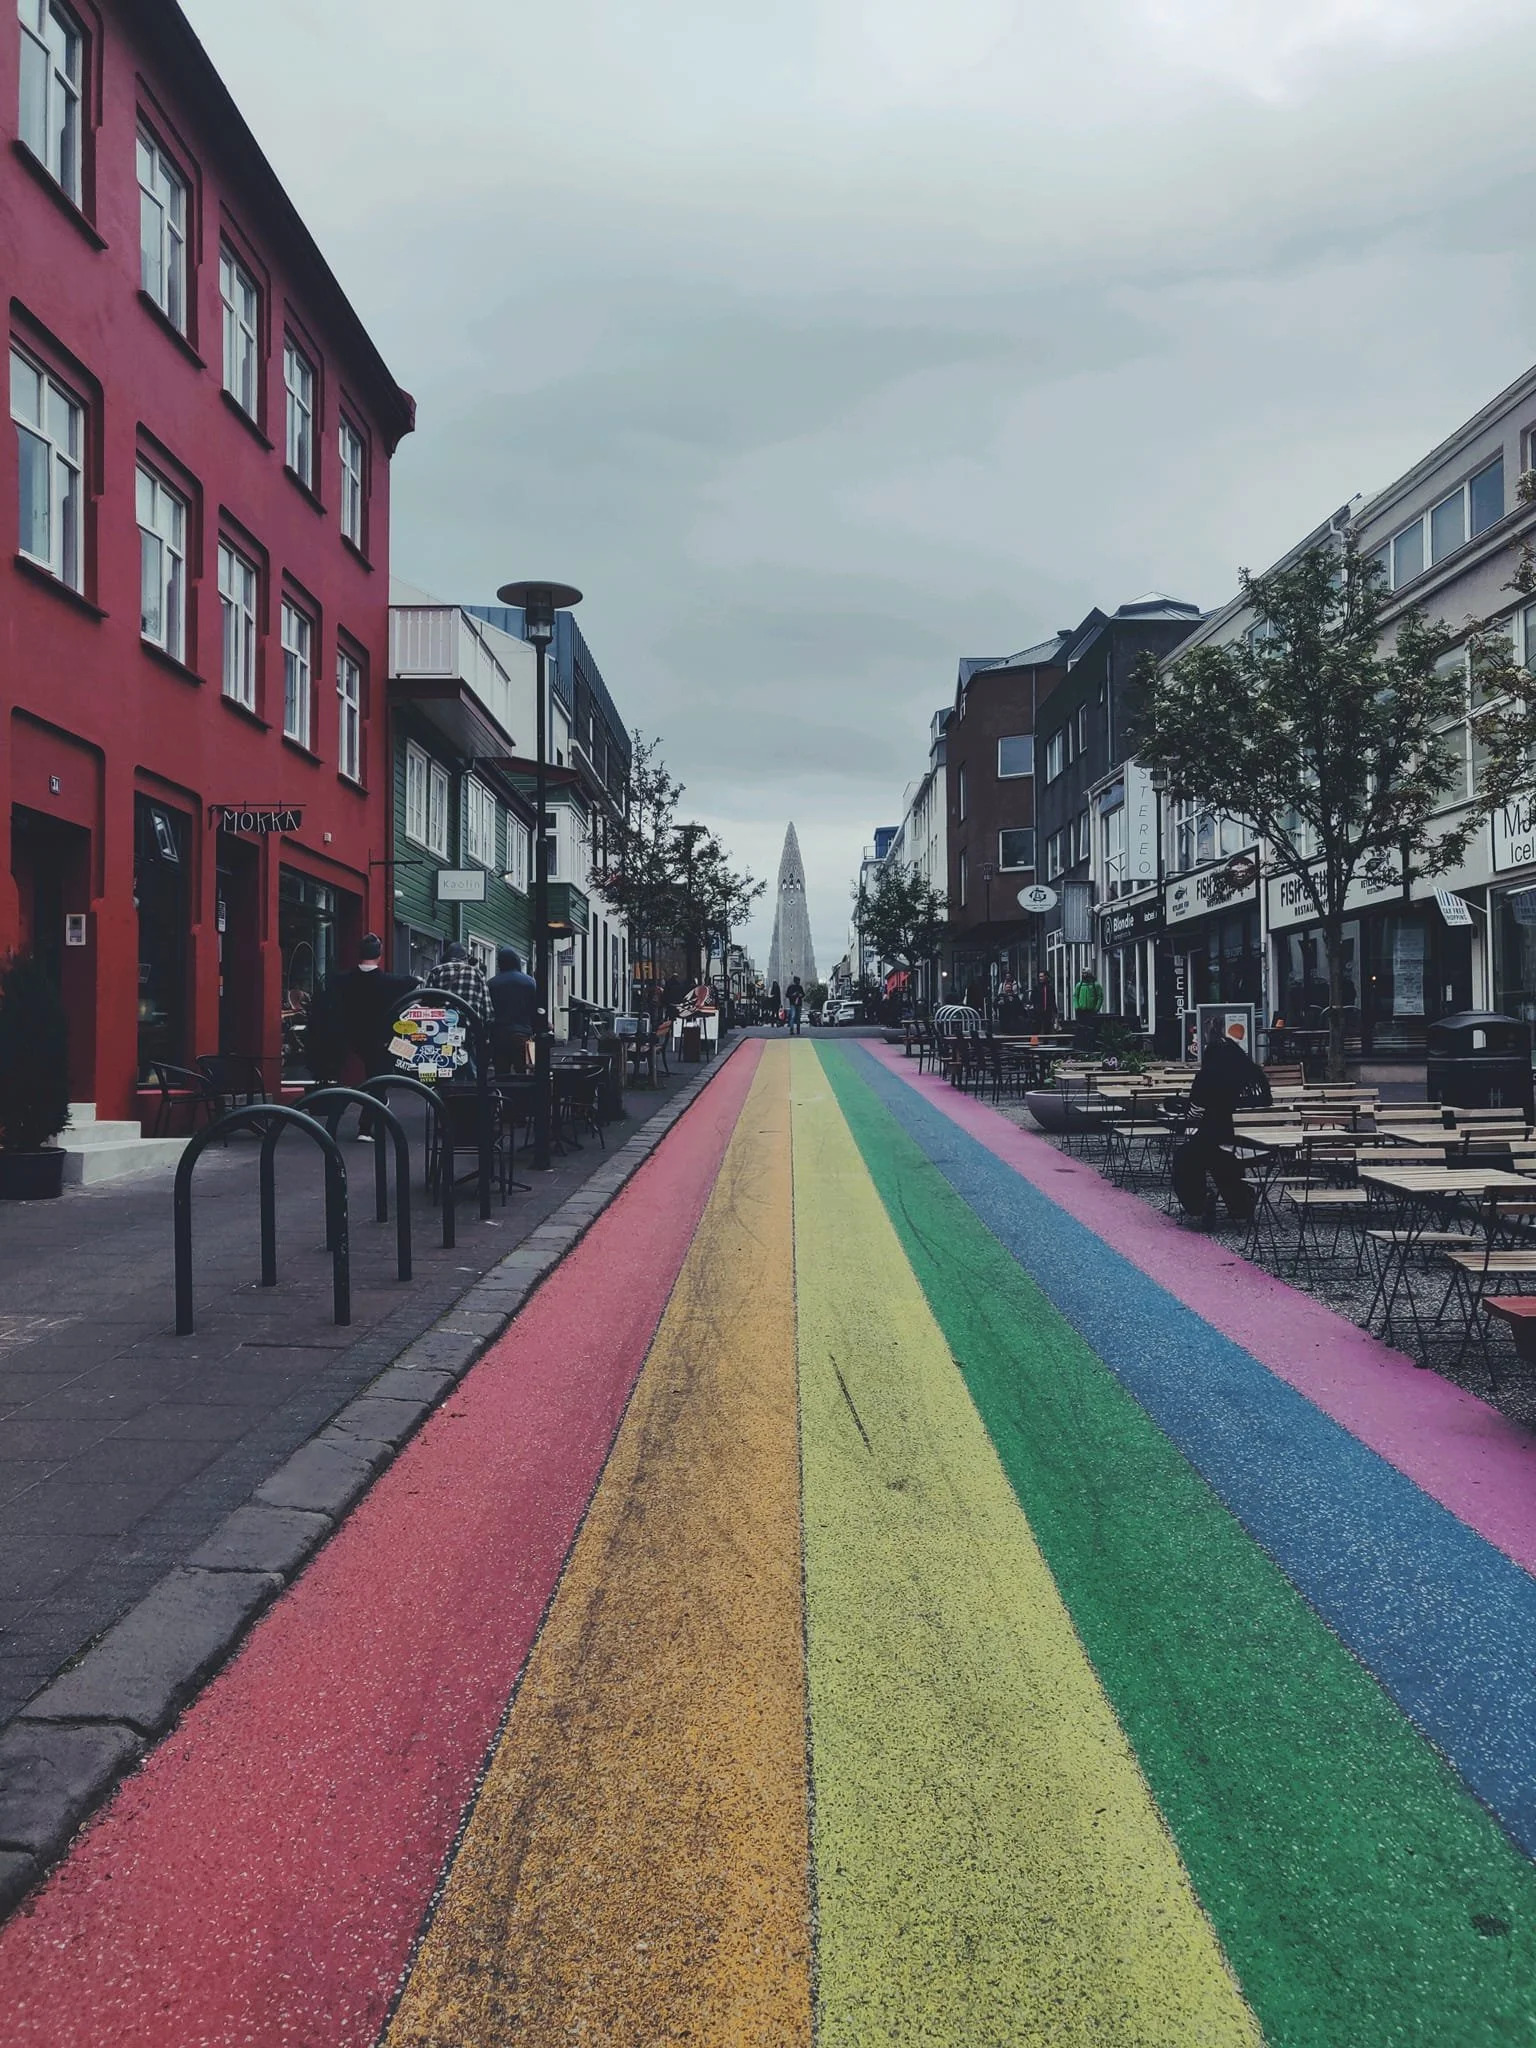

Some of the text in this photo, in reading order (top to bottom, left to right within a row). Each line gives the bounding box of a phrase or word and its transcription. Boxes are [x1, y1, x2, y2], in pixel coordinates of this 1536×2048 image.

[223, 810, 299, 835] MOKKA
[443, 879, 481, 889] Kaolin
[1196, 875, 1214, 901] FISH
[1280, 877, 1309, 908] FISH
[1113, 912, 1134, 932] Blondie
